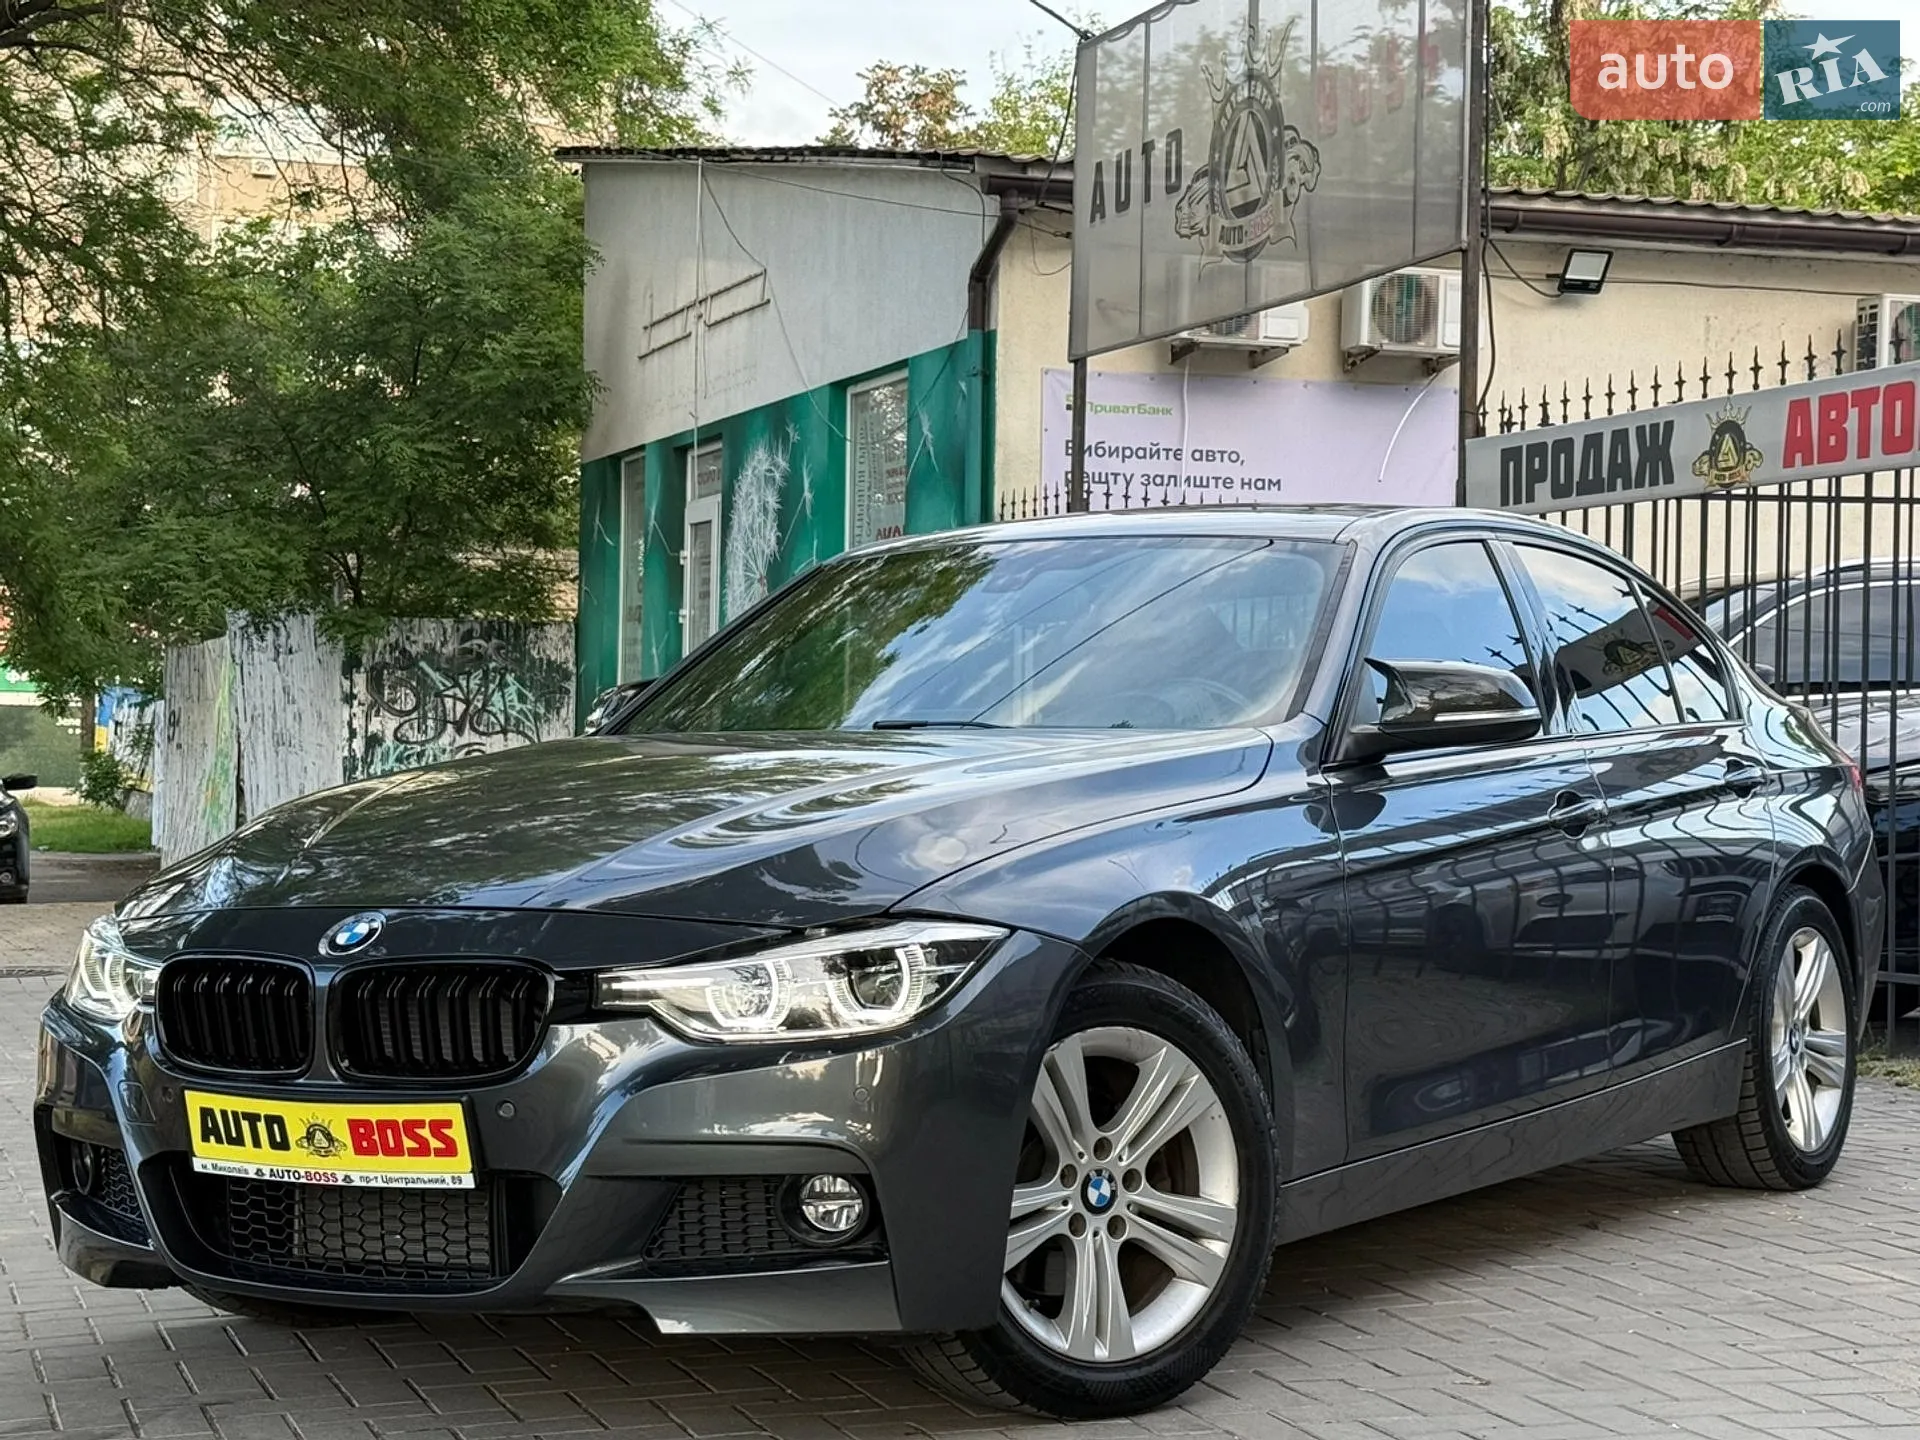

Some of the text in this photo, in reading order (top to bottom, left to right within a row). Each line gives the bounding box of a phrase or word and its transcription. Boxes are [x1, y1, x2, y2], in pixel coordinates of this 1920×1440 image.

[1090, 128, 1183, 224] AUTO
[1190, 448, 1246, 466] авто,
[1500, 381, 1920, 507] ПРОДАЖ АВТО
[1140, 473, 1234, 490] залиште
[1240, 477, 1282, 492] нам
[199, 1106, 458, 1157] AUTO BOSS
[269, 1168, 339, 1183] AUTO-BOSS
